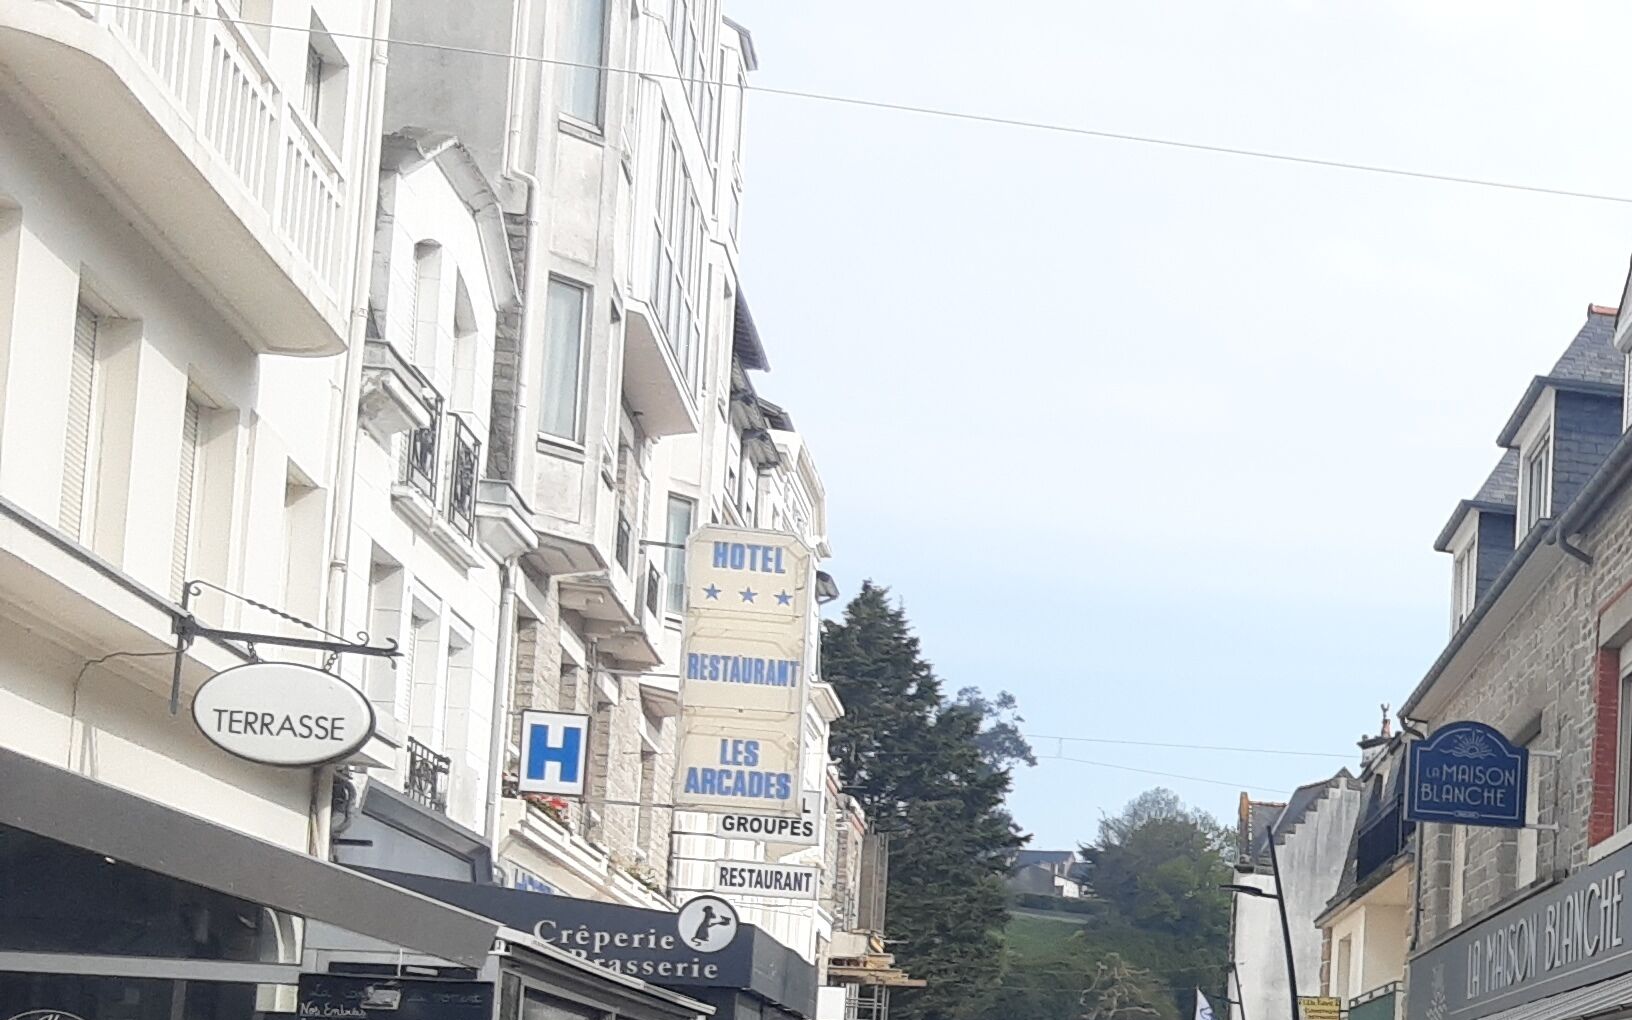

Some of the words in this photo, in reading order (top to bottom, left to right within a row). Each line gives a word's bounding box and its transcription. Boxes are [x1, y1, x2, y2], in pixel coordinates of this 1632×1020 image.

[712, 541, 786, 574] HOTEL
[687, 652, 799, 687] RESTAURANT
[213, 709, 345, 741] TERRASSE
[527, 723, 582, 783] H
[720, 738, 760, 767] LES
[684, 767, 791, 800] ARCADES
[1426, 767, 1439, 778] LA
[1442, 763, 1515, 786] MAISON
[1421, 783, 1506, 807] BLANCHE
[722, 815, 813, 837] GROUPES
[719, 866, 812, 892] RESTAURANT
[534, 919, 675, 953] Crêperie
[1467, 940, 1481, 999] LA
[1485, 913, 1539, 993] MAISON
[1545, 869, 1626, 972] BLANCHE
